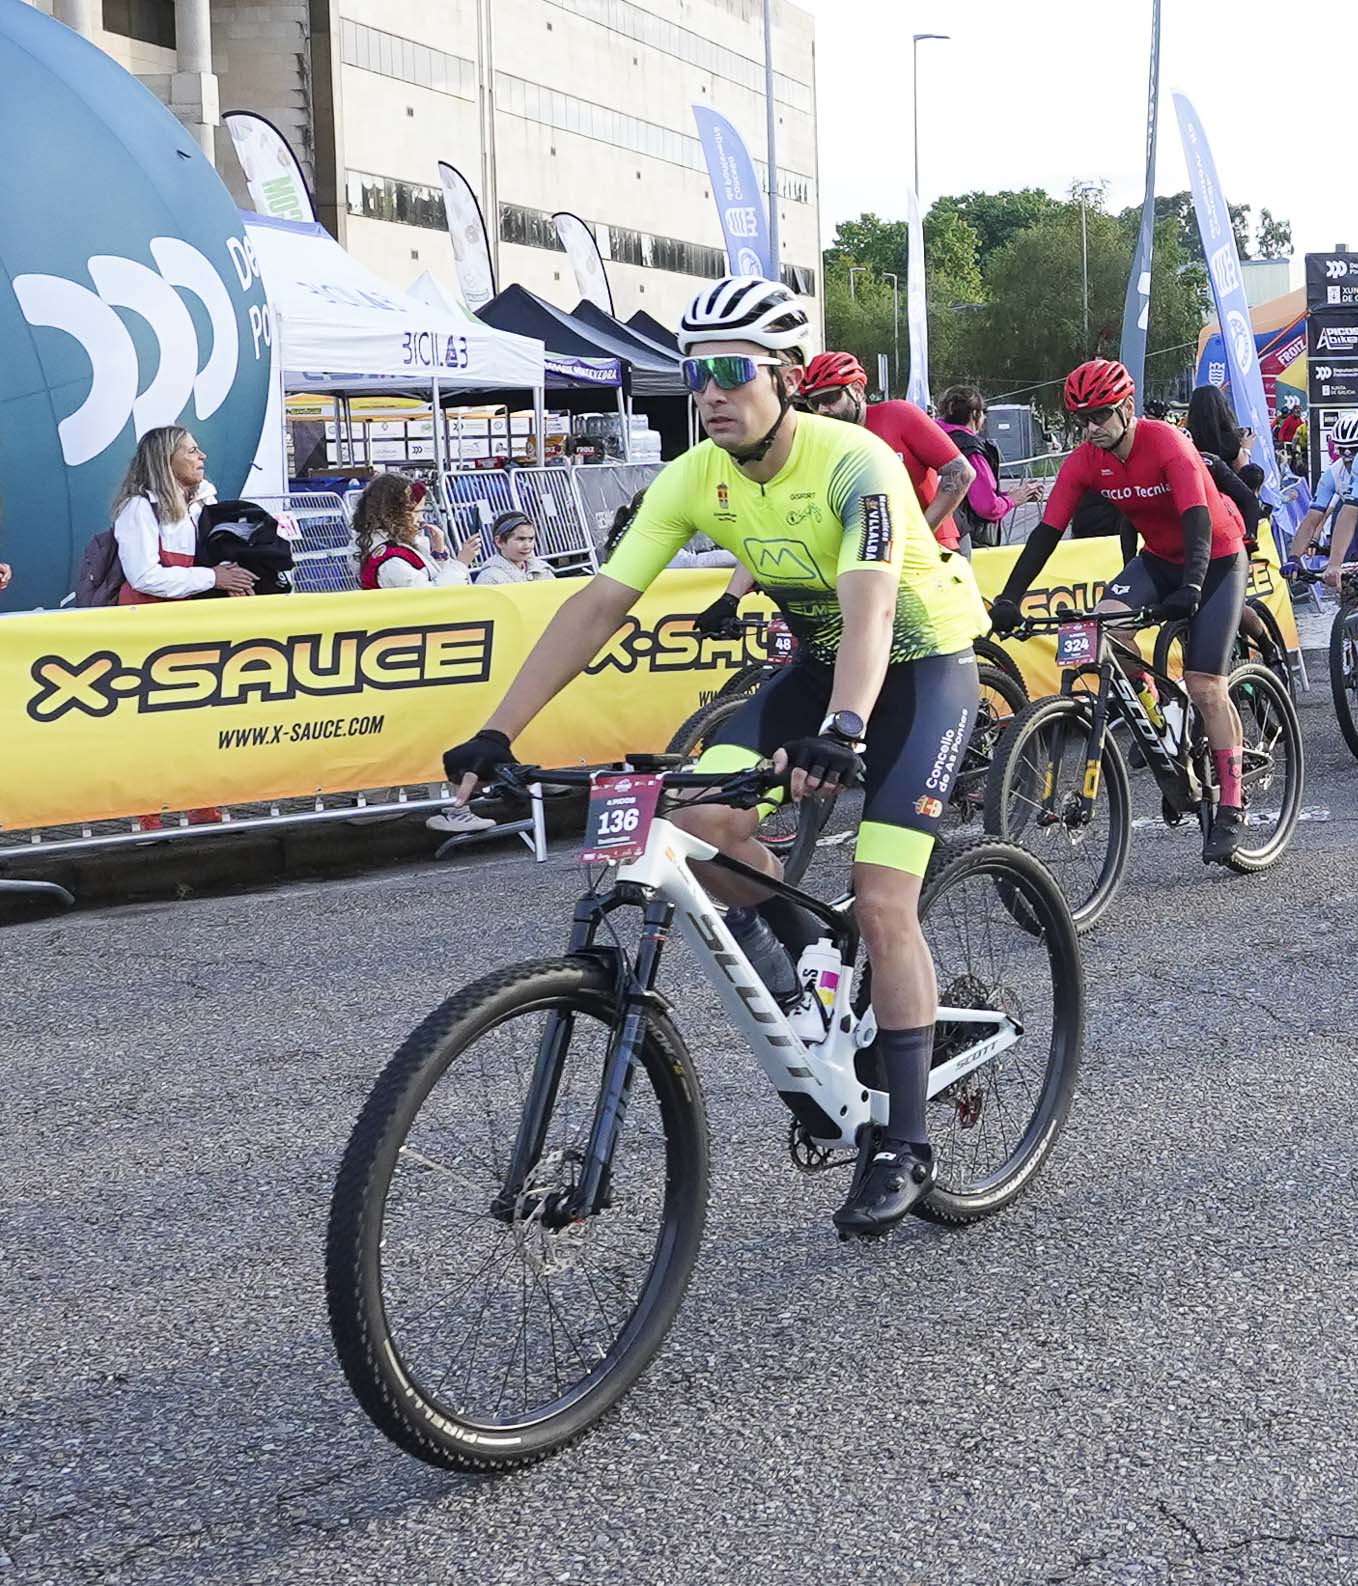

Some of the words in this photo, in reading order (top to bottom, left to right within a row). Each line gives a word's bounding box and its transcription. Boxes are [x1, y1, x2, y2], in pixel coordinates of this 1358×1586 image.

[775, 637, 791, 650] 48
[1064, 638, 1090, 652] 324
[217, 715, 385, 750] WWW.X-SAUCE.COM
[926, 729, 955, 789] Concello
[939, 774, 951, 792] de
[597, 807, 640, 835] 136
[954, 1041, 999, 1069] SCOTT
